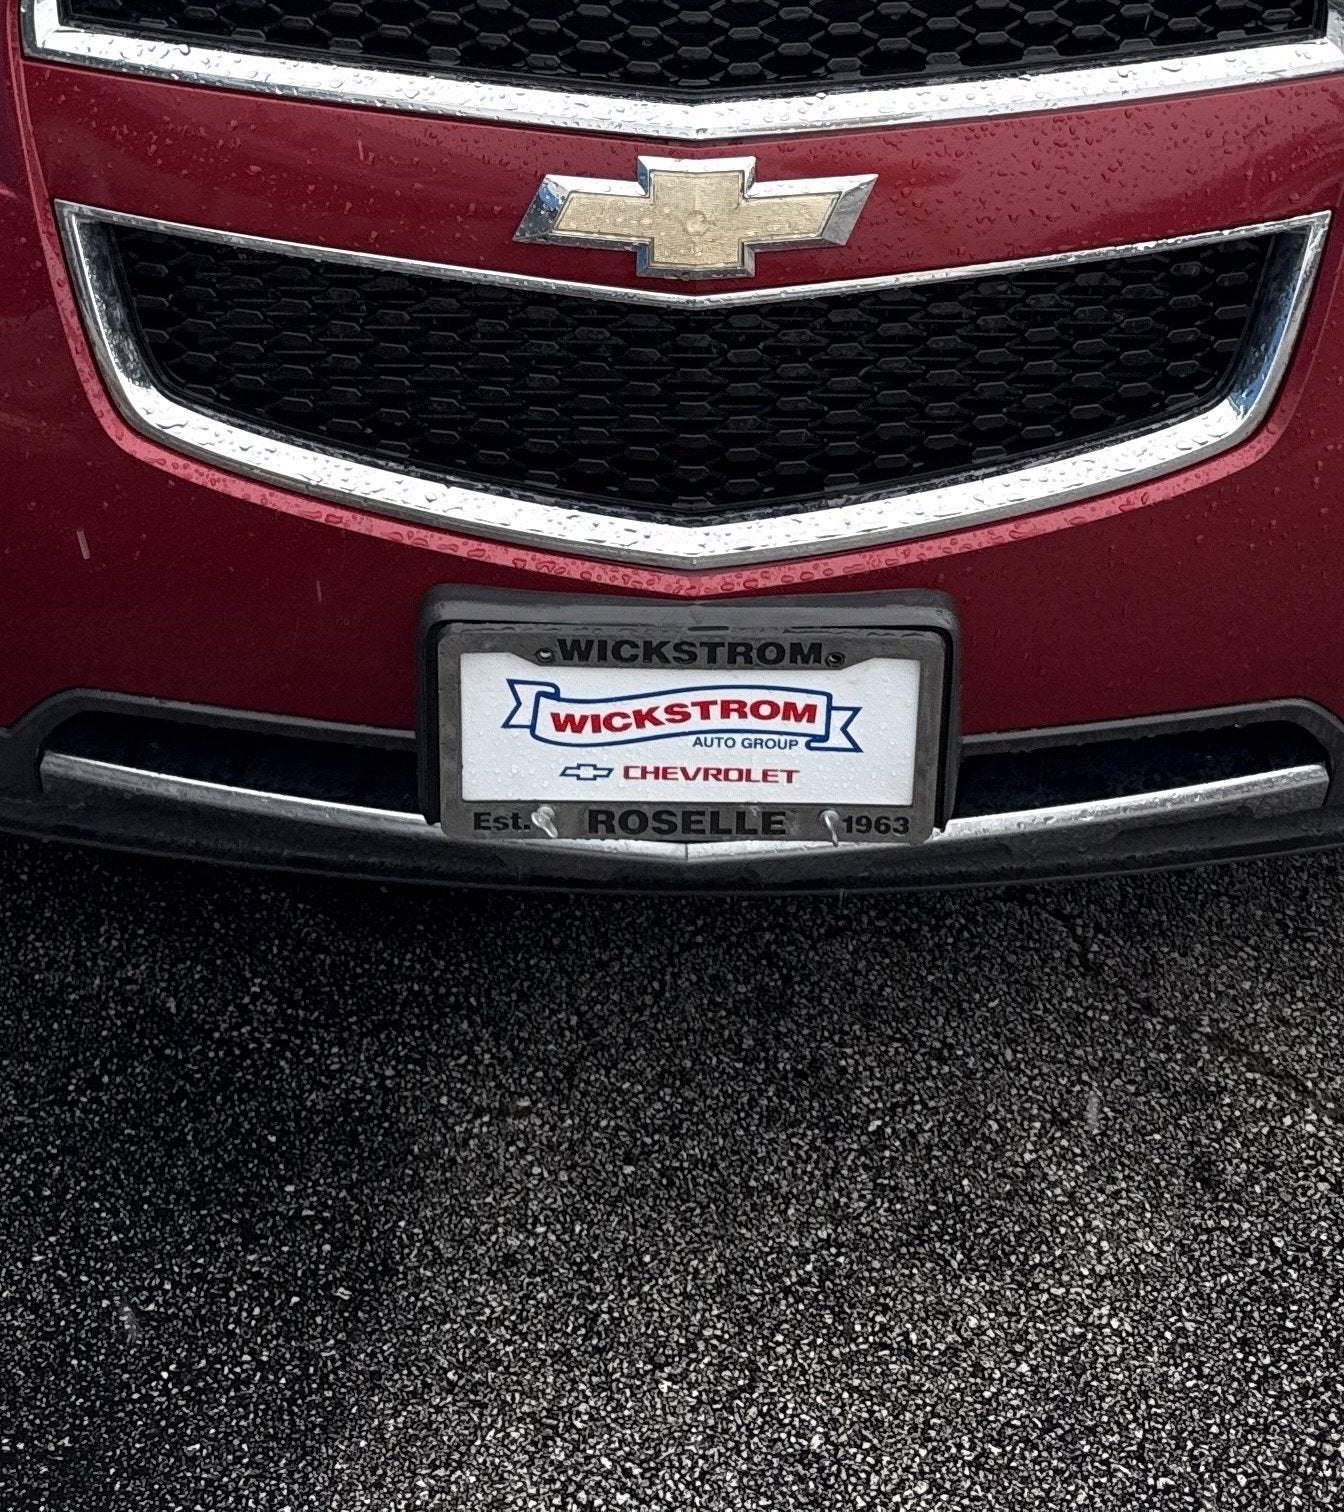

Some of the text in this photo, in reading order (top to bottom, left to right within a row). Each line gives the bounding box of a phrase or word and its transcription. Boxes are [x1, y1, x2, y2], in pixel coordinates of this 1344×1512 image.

[556, 638, 823, 666] WICKSTROM
[550, 698, 818, 734] WICKSTROM
[692, 736, 799, 750] AUTO GROUP
[623, 765, 800, 784] CHEVROLET
[473, 809, 910, 835] Est. ROSELLE 1963
